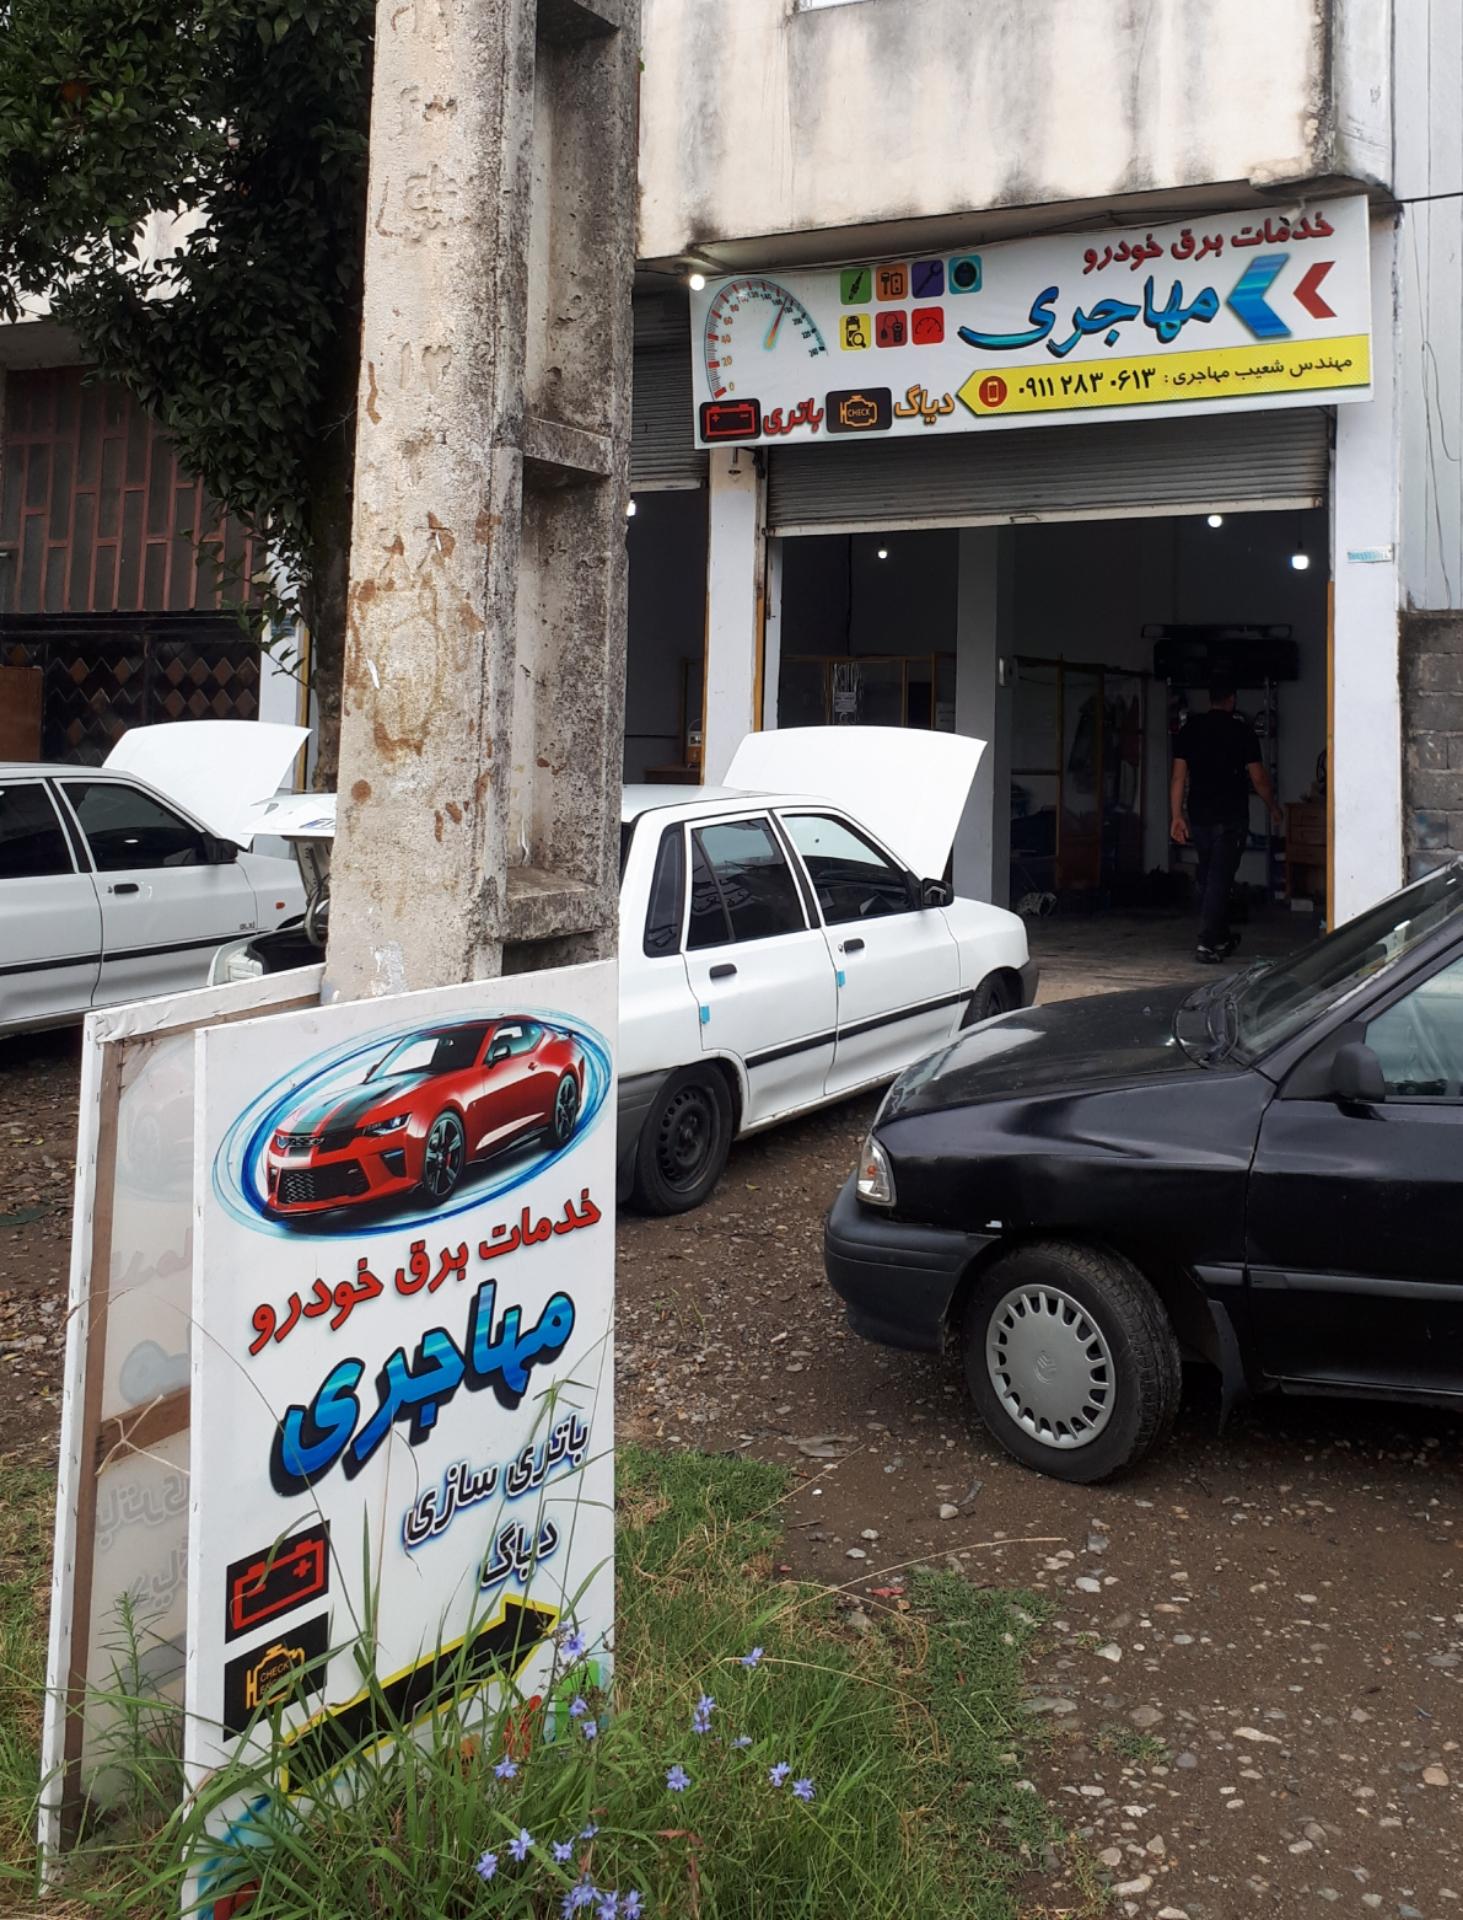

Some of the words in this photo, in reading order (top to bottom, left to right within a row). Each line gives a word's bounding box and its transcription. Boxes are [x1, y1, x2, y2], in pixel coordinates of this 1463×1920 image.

[1170, 228, 1224, 262] برق
[1230, 211, 1335, 250] خدمات
[1082, 232, 1165, 275] خودرو
[957, 275, 1221, 358] مهاجری
[1018, 375, 1055, 398] ۰۹۱۱
[1060, 371, 1104, 396] ۲۸۳
[1110, 367, 1156, 391] ۰۶۱۳
[1233, 359, 1285, 381] شعیب
[1289, 356, 1353, 378] مهندس
[763, 397, 825, 438] باتری
[847, 409, 870, 418] CHECK
[894, 383, 956, 425] دیاگ
[478, 1188, 603, 1262] خدمات
[394, 1239, 469, 1294] برق
[248, 1257, 385, 1355] خودرو
[270, 1278, 576, 1496] مهاجری
[505, 1414, 589, 1496] باتری
[404, 1459, 500, 1545] سازی
[260, 1662, 289, 1682] CHECK
